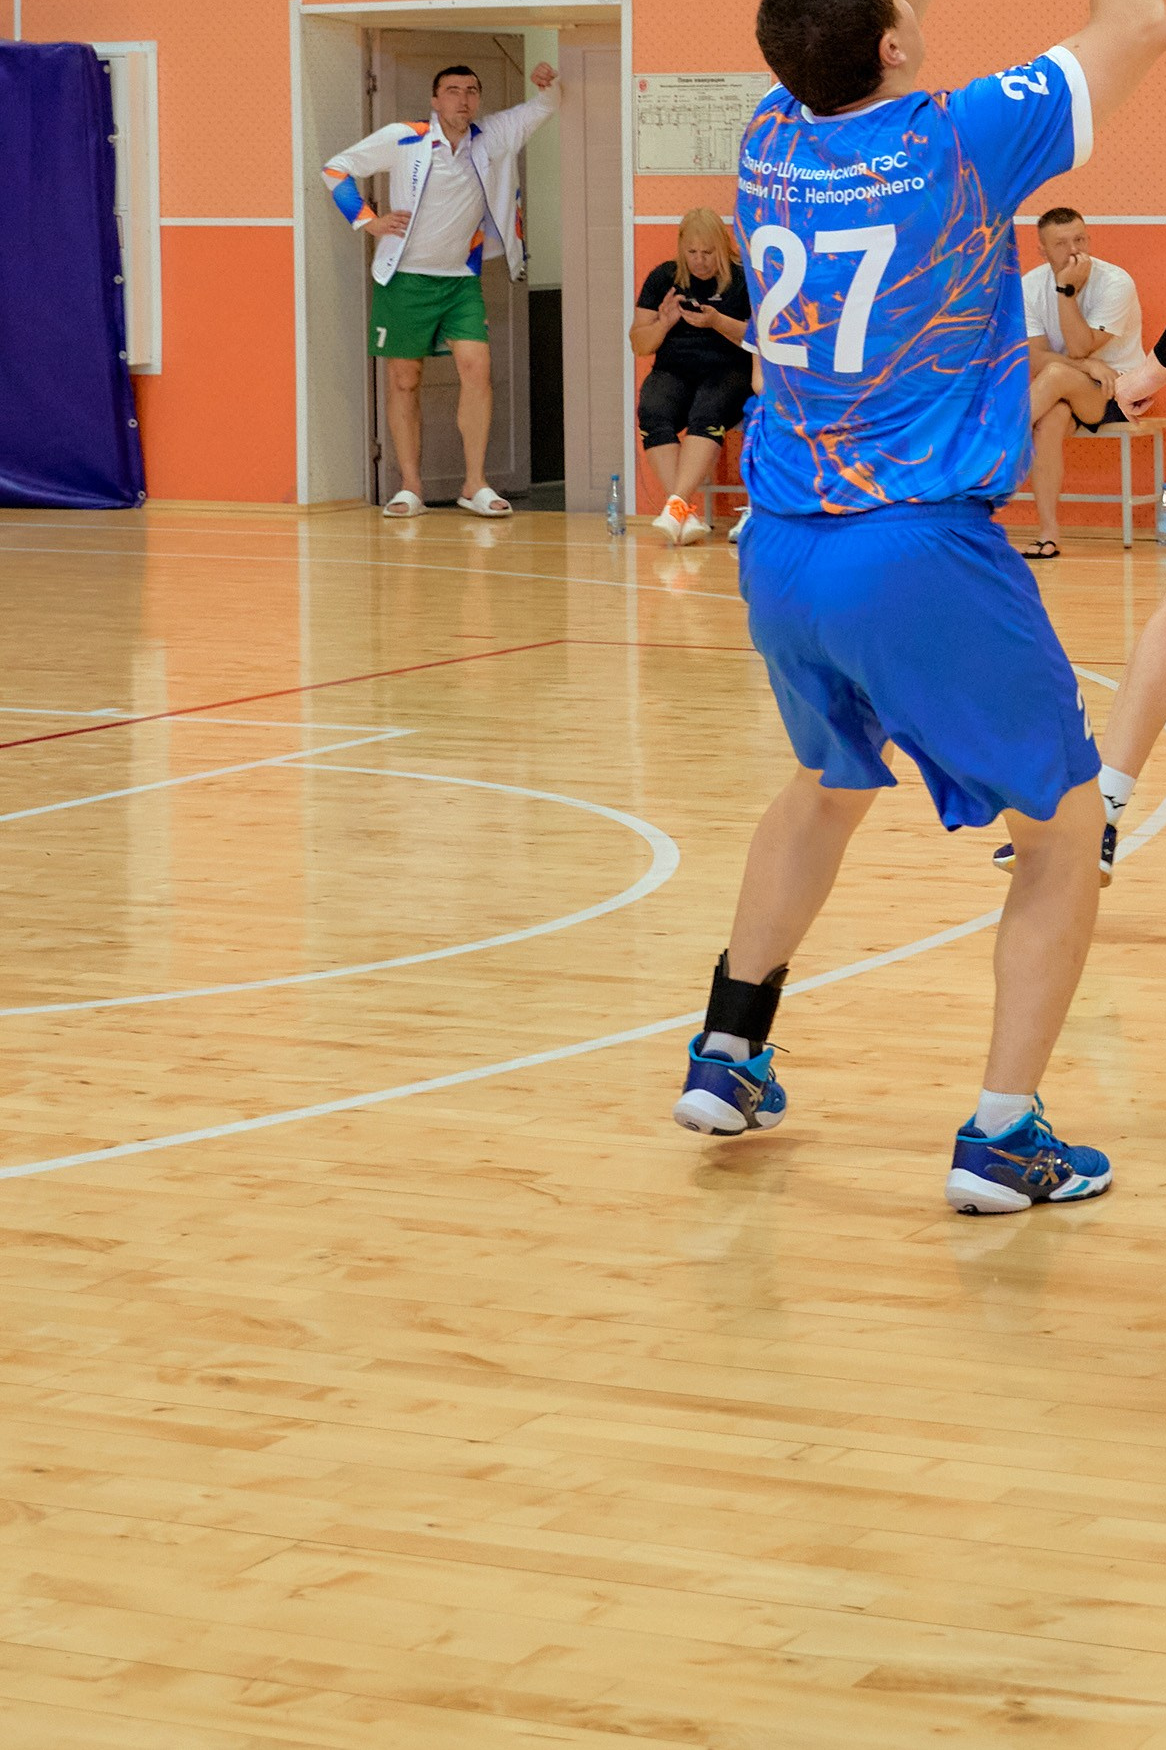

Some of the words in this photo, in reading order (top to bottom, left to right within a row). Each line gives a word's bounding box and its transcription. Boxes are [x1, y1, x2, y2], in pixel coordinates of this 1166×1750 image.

[871, 151, 909, 173] ГЭС
[771, 185, 802, 203] П.С.
[805, 177, 925, 206] Непорожнего
[750, 223, 897, 373] 27
[376, 327, 387, 348] 7
